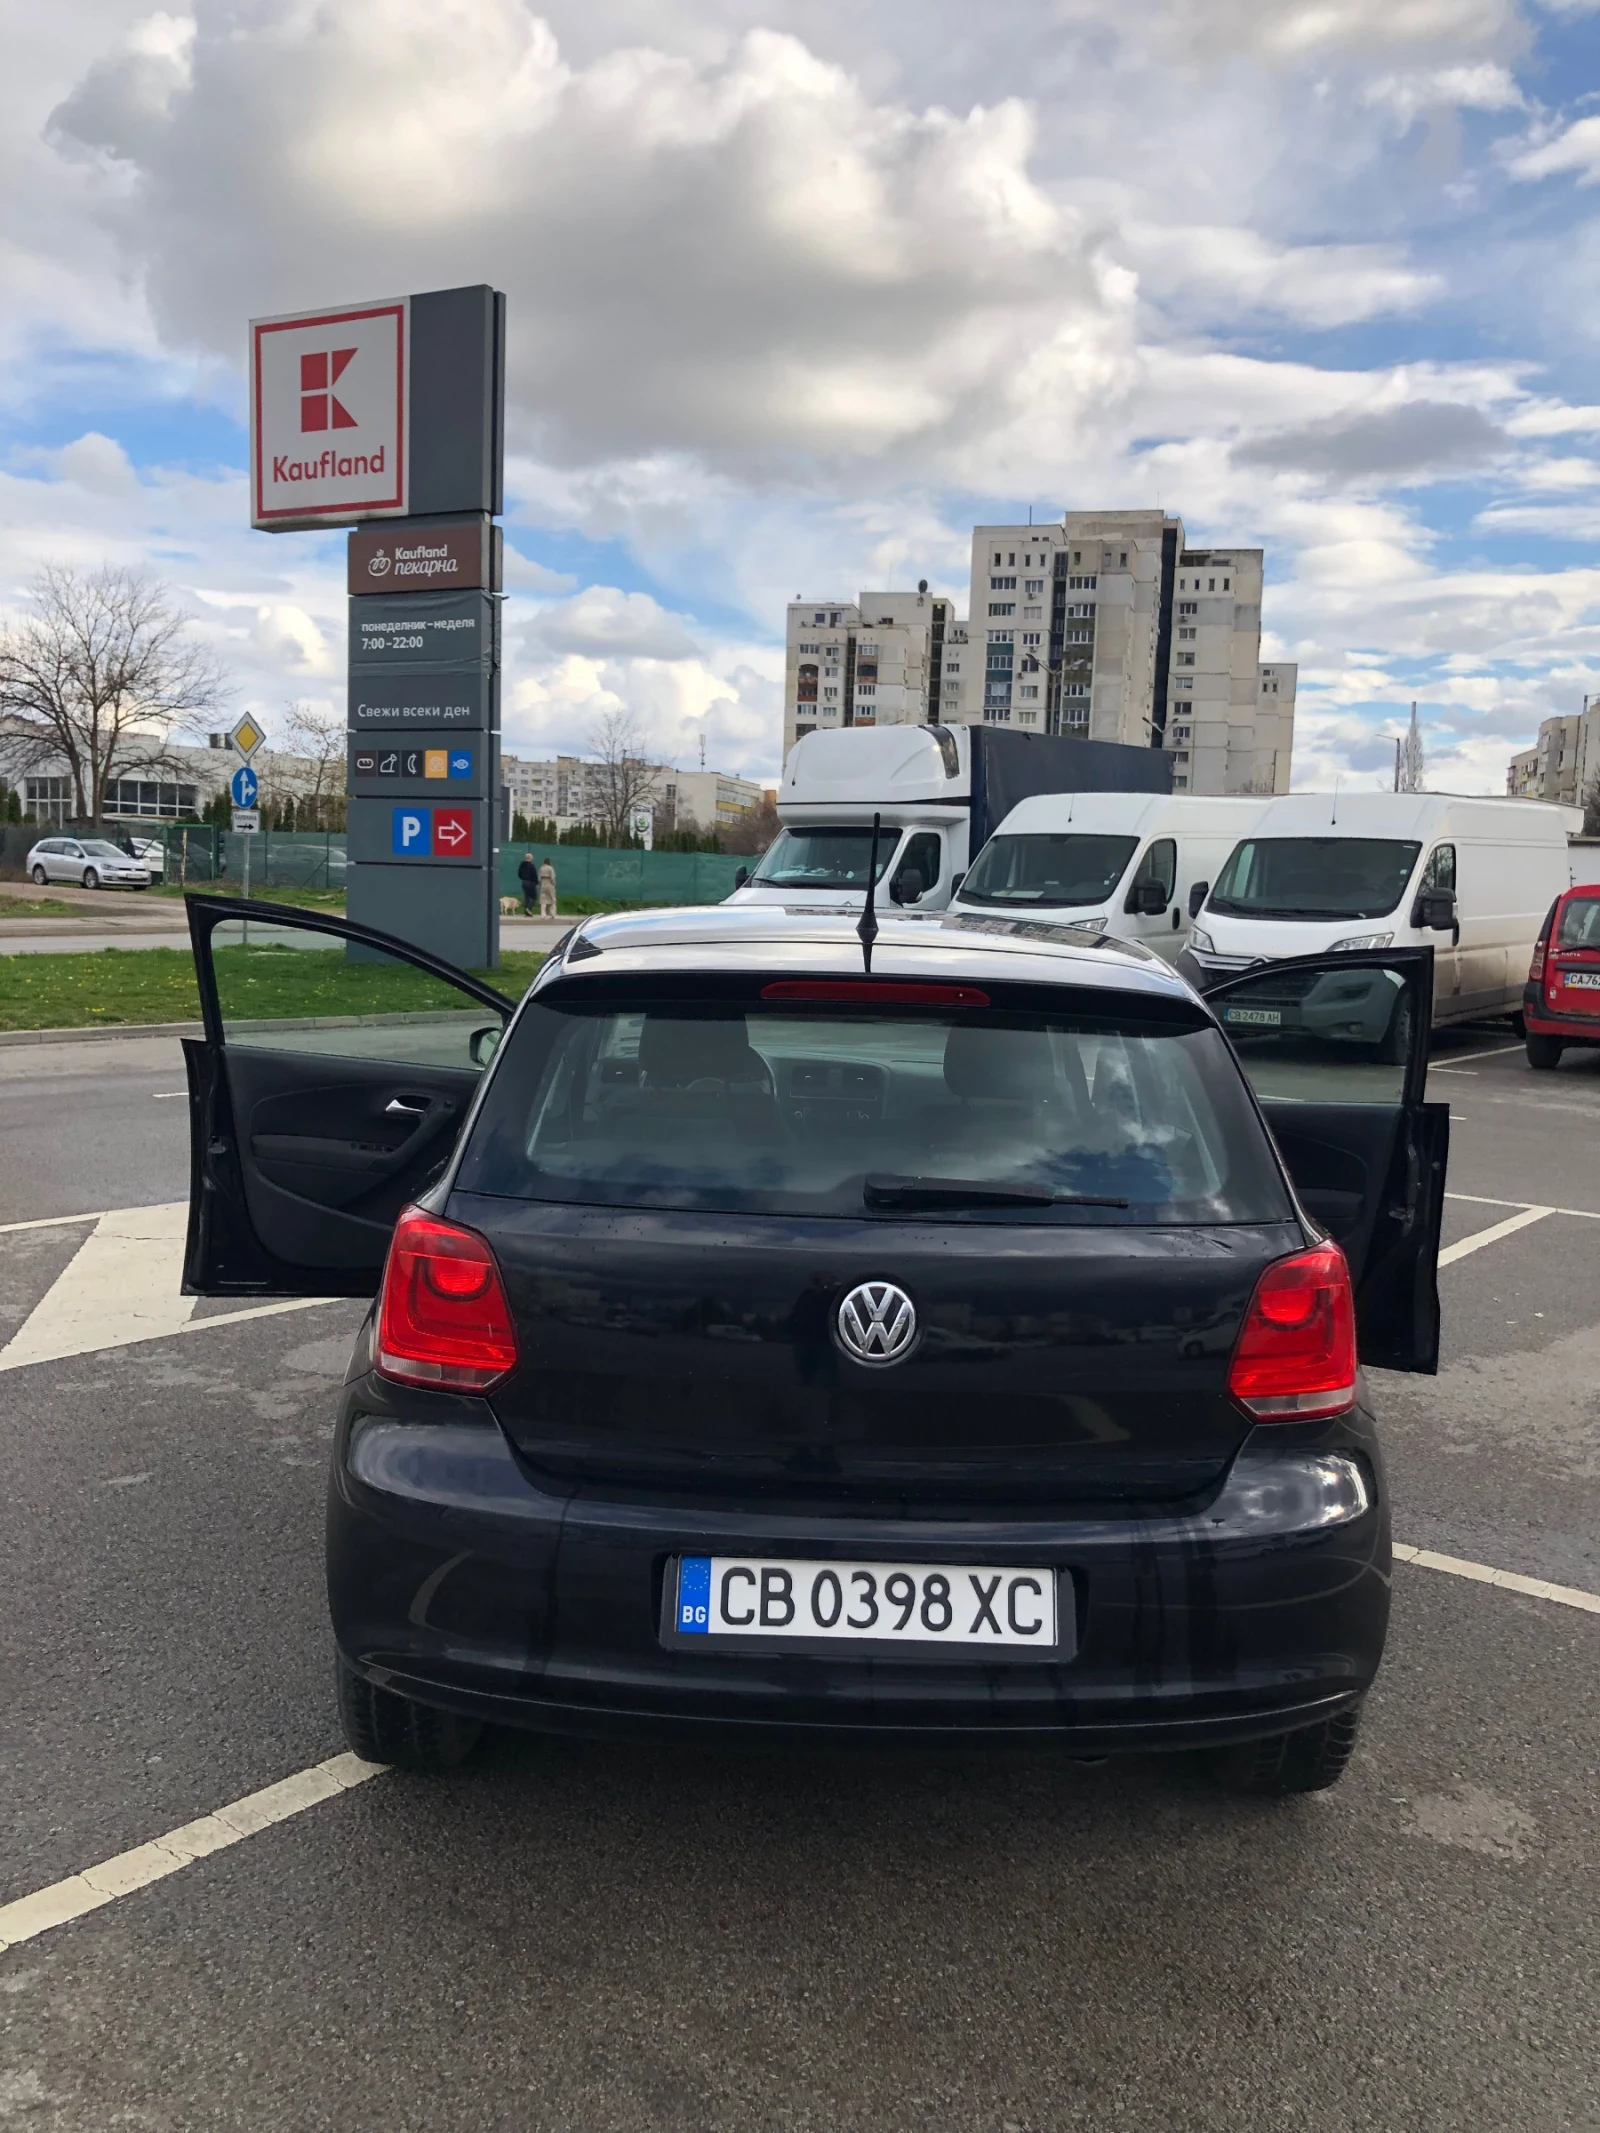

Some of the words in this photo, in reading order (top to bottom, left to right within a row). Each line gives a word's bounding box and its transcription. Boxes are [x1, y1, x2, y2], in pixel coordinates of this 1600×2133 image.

[273, 445, 385, 483] Kaufland
[395, 544, 448, 560] Kaufland
[394, 558, 458, 577] пекарна
[357, 704, 400, 718] Свежи
[402, 706, 440, 717] всеки
[443, 705, 470, 719] ден
[402, 816, 421, 847] P
[1570, 975, 1583, 985] CA
[1585, 975, 1600, 986] 76
[720, 1567, 795, 1626] CB
[811, 1569, 953, 1632] 0398
[968, 1574, 1043, 1636] XC
[682, 1605, 707, 1624] BG
